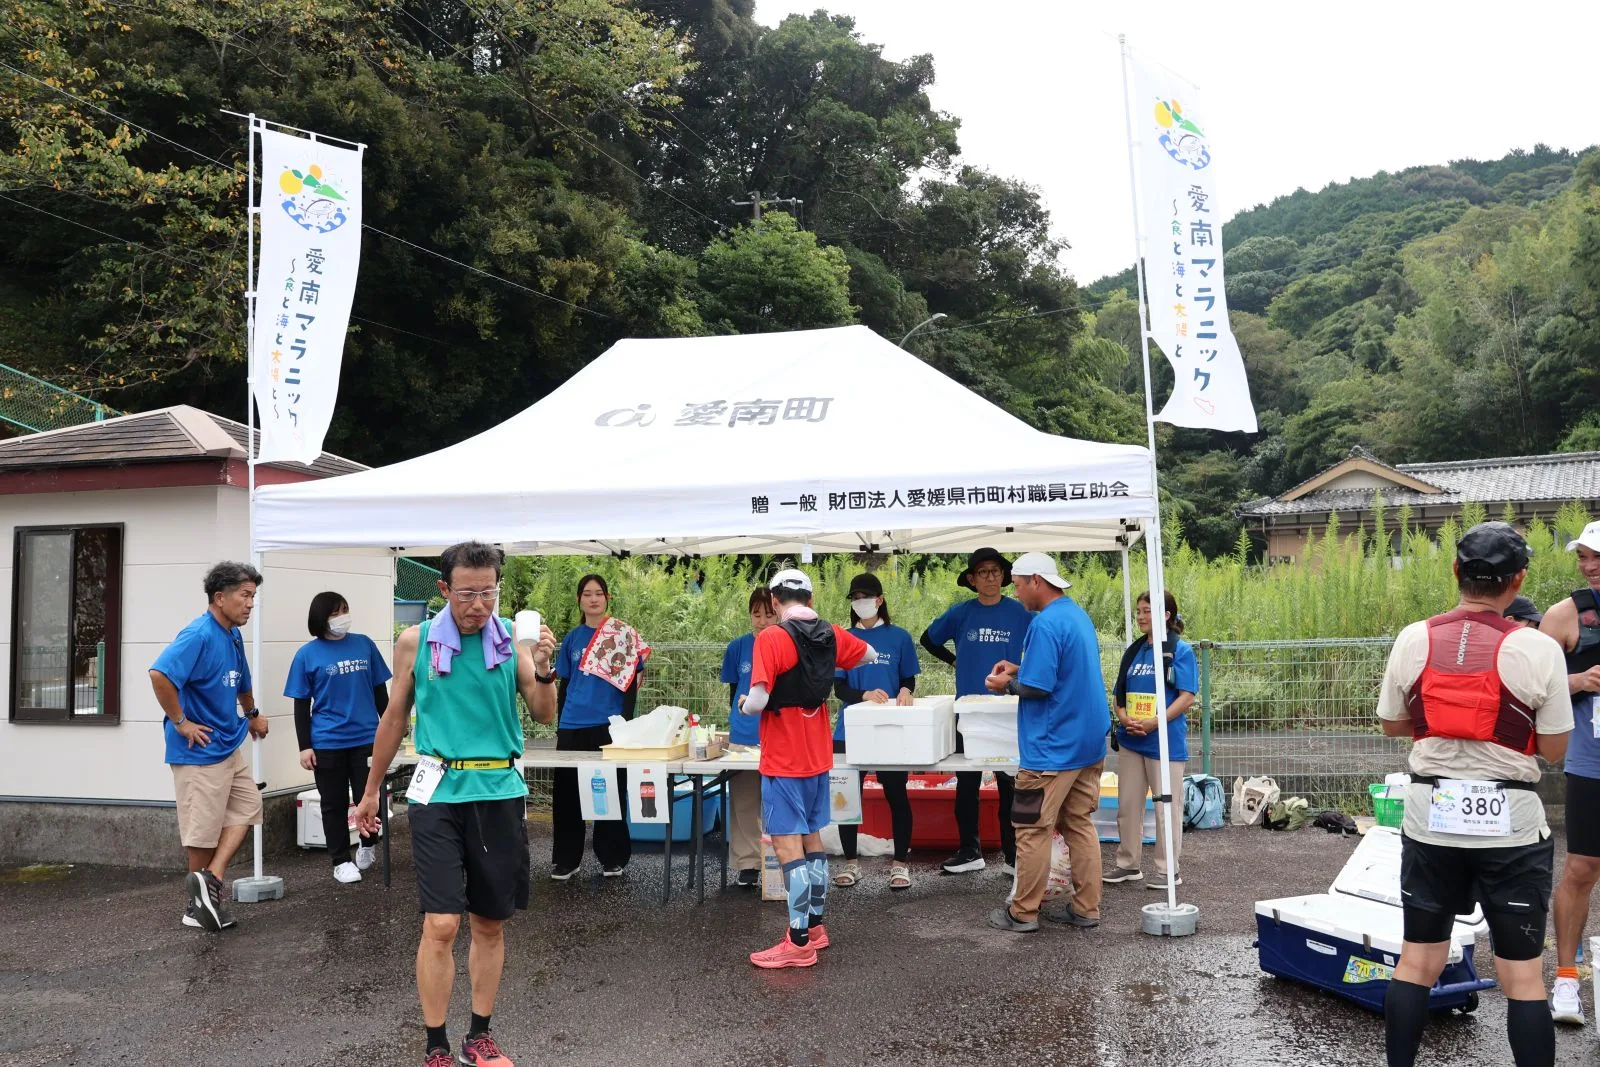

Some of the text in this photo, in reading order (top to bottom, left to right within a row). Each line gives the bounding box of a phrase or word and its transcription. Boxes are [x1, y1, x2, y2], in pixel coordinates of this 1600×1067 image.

[1188, 184, 1218, 391] 愛南マラニック
[285, 248, 326, 428] 愛南マラニック
[673, 396, 834, 429] 愛南町
[751, 480, 1129, 514] 贈 一般 財団法人愛媛県市町村職員互助会
[978, 635, 1000, 643] 2026
[1456, 622, 1471, 665] SALOMON
[339, 665, 360, 675] 2026
[416, 769, 426, 784] 6
[1461, 797, 1502, 816] 380
